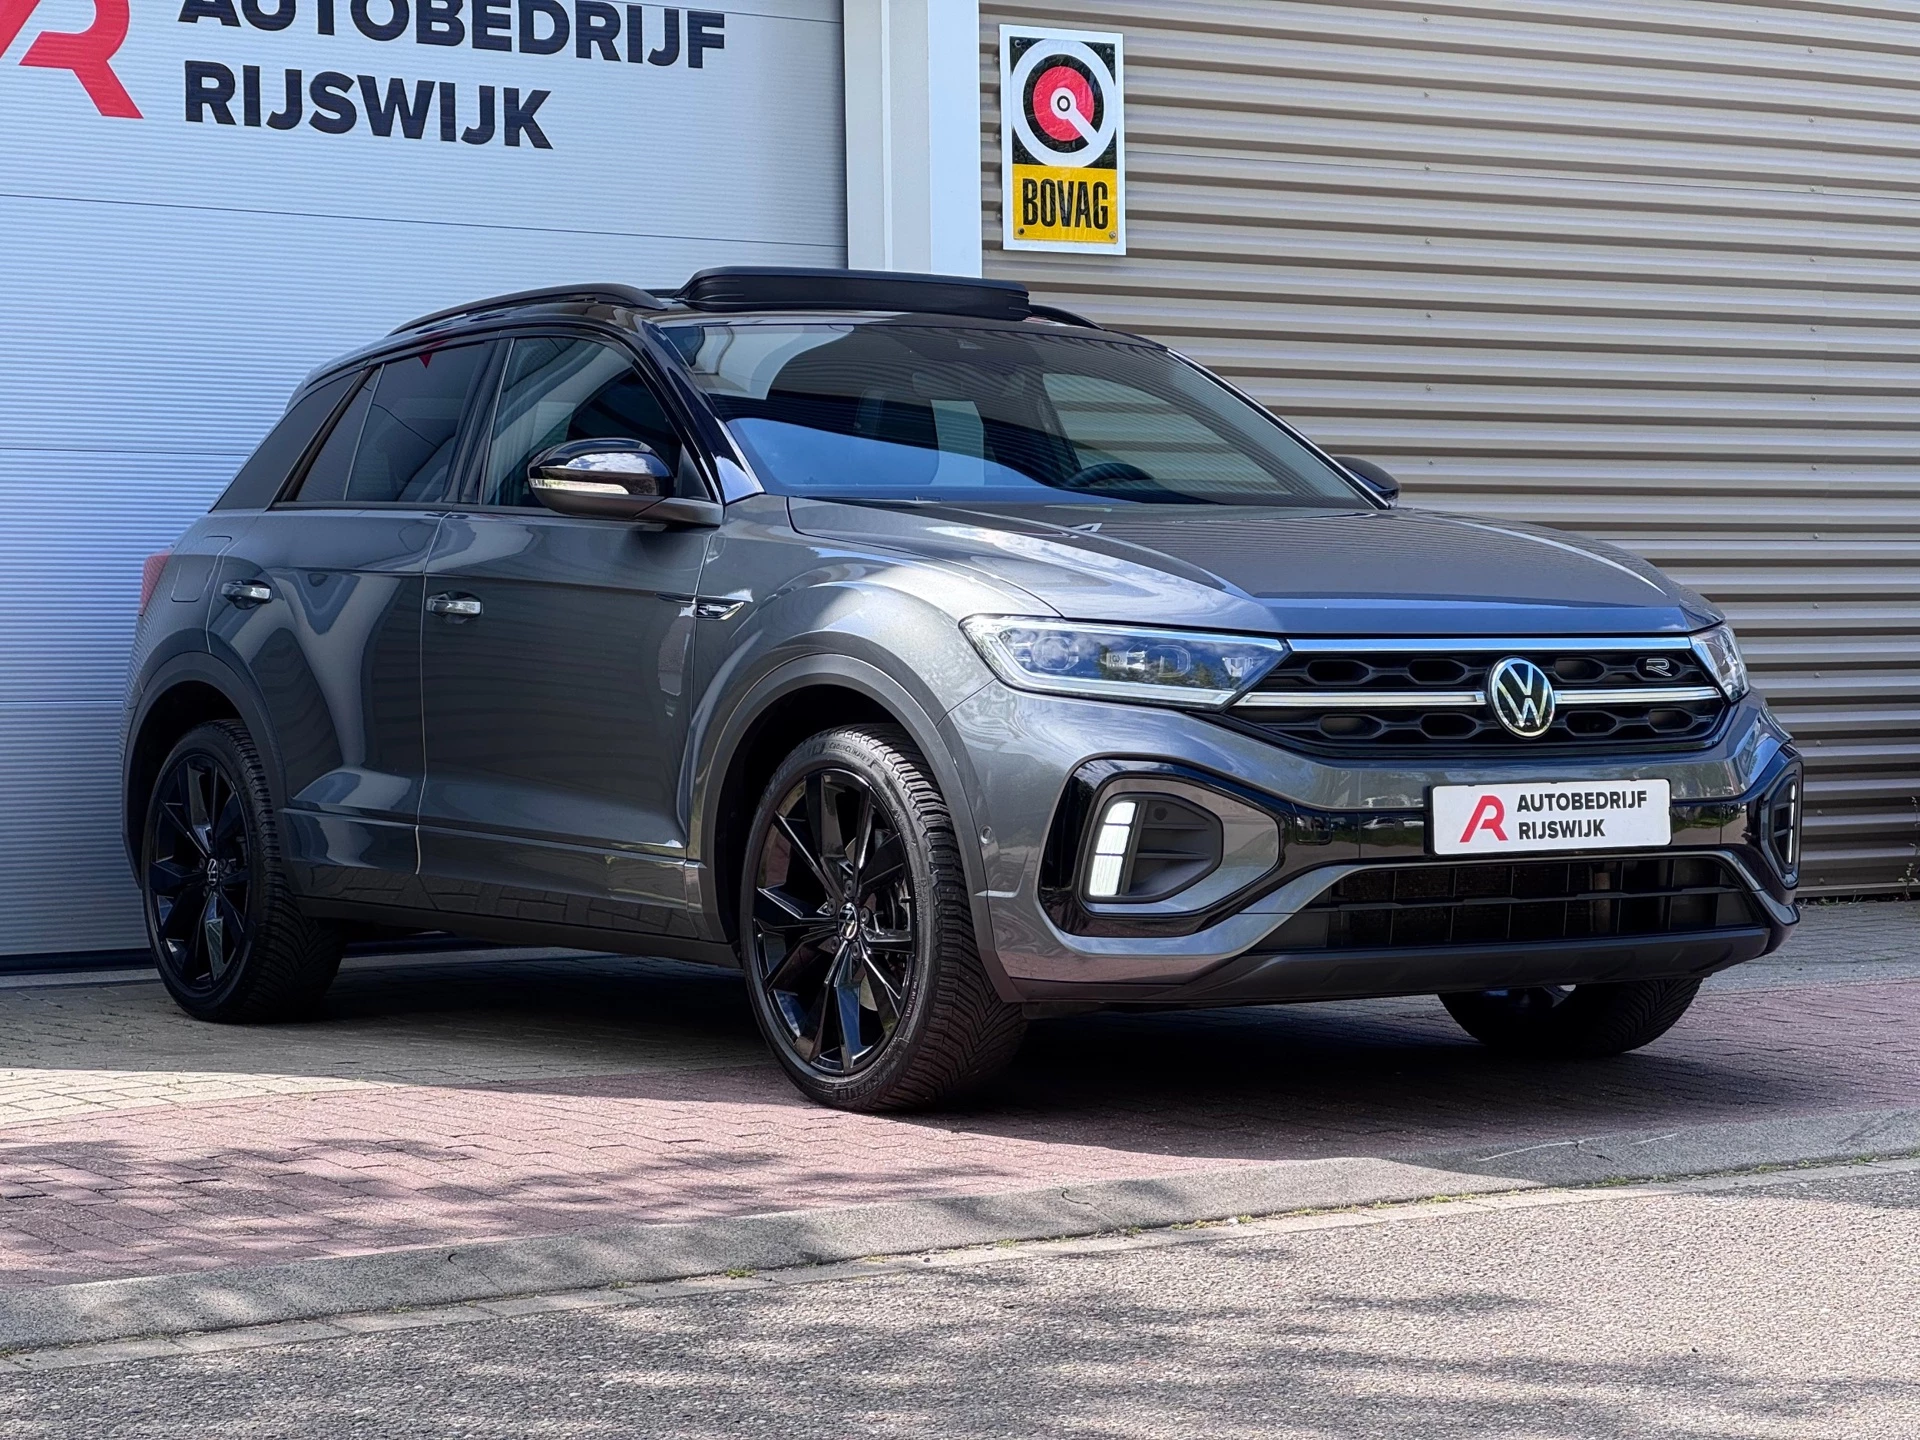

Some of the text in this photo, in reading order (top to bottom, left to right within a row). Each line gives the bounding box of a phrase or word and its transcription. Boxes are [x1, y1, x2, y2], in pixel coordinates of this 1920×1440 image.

[184, 60, 553, 149] RIJSWIJK
[1022, 178, 1109, 229] BOVAG
[1517, 790, 1648, 812] AUTOBEDRIJF
[1518, 819, 1606, 840] RIJSWIJK
